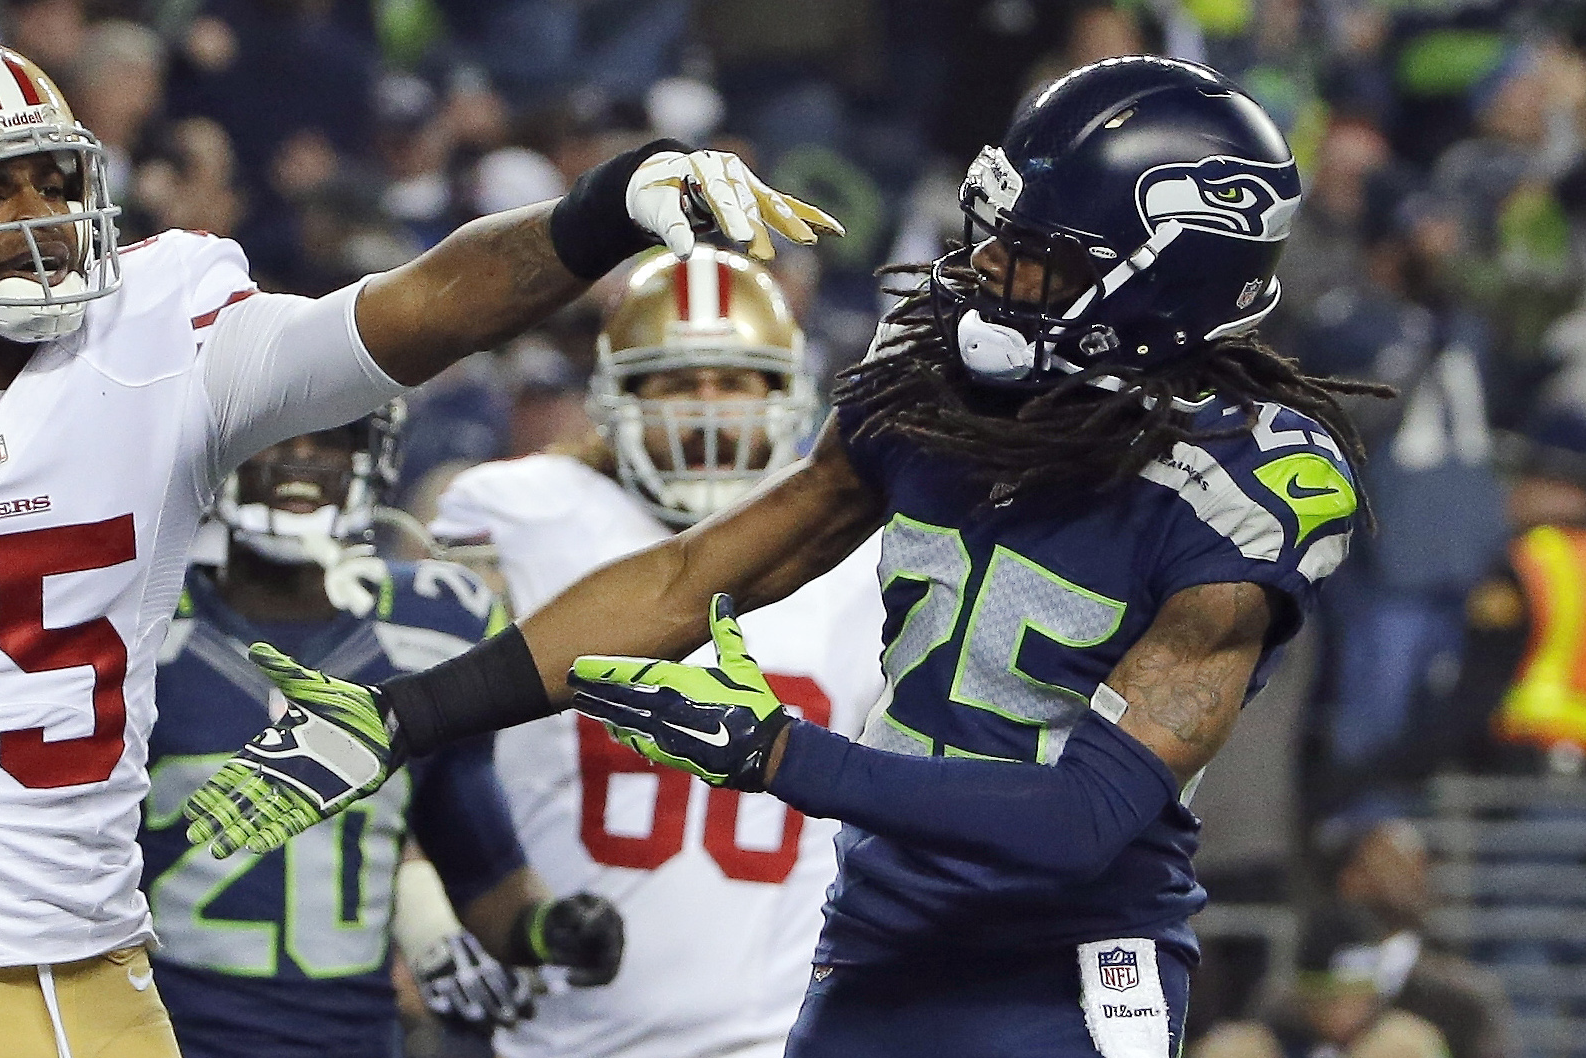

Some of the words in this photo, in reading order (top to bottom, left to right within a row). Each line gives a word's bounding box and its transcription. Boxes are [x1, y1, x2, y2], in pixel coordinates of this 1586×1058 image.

[853, 511, 1128, 768] 25
[146, 752, 414, 979] 20
[1101, 1004, 1157, 1019] Wilson
[1103, 966, 1136, 988] NFL
